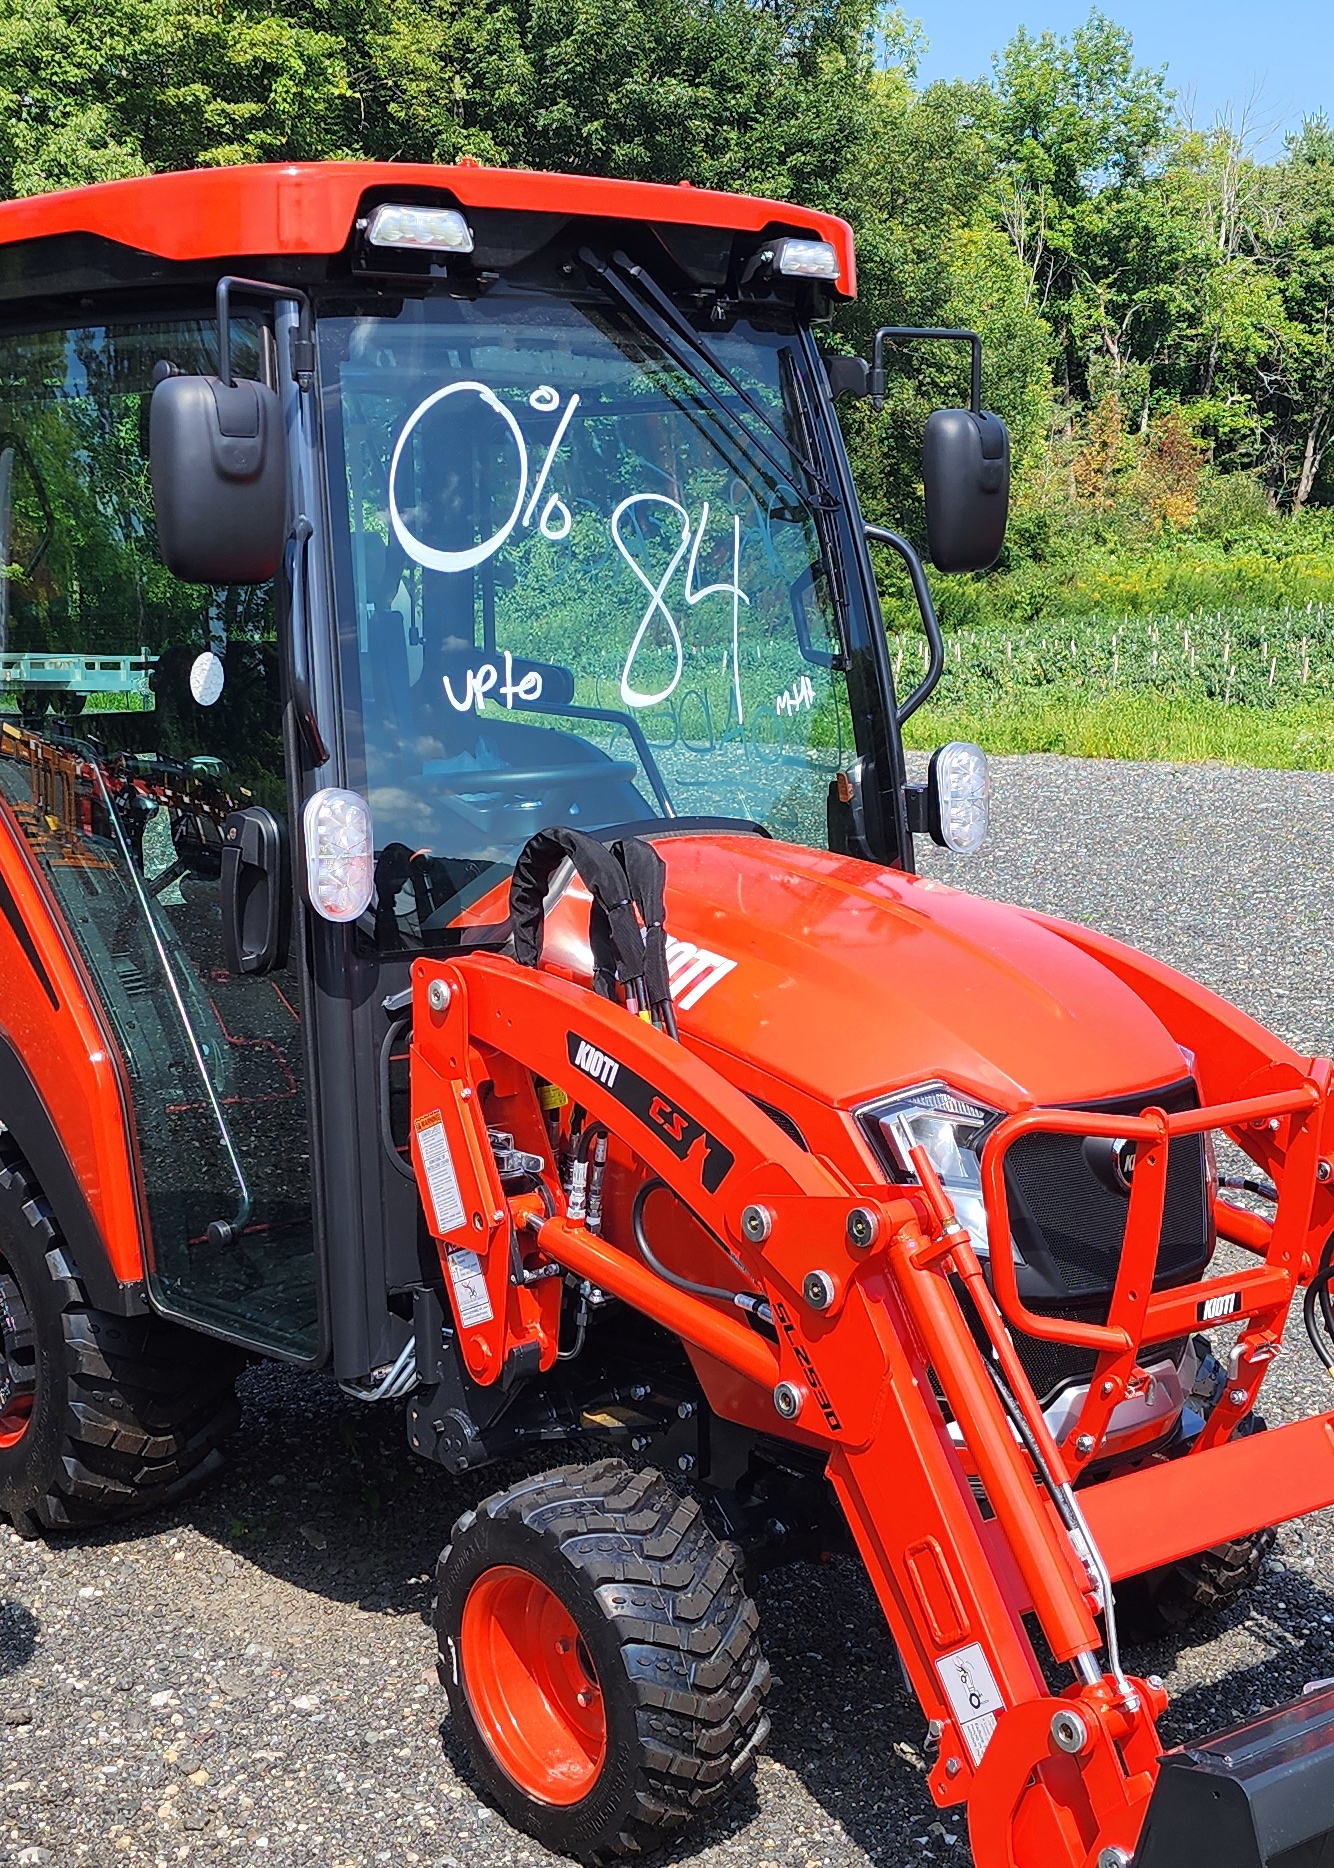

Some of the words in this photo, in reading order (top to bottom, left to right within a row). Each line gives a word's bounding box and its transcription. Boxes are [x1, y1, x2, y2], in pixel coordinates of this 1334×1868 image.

[389, 381, 580, 573] 0%
[612, 493, 750, 725] 84
[641, 927, 739, 1010] OTI
[574, 1040, 619, 1088] KIOTI
[1203, 1293, 1236, 1320] KIOTI
[772, 1302, 843, 1431] SL2530
